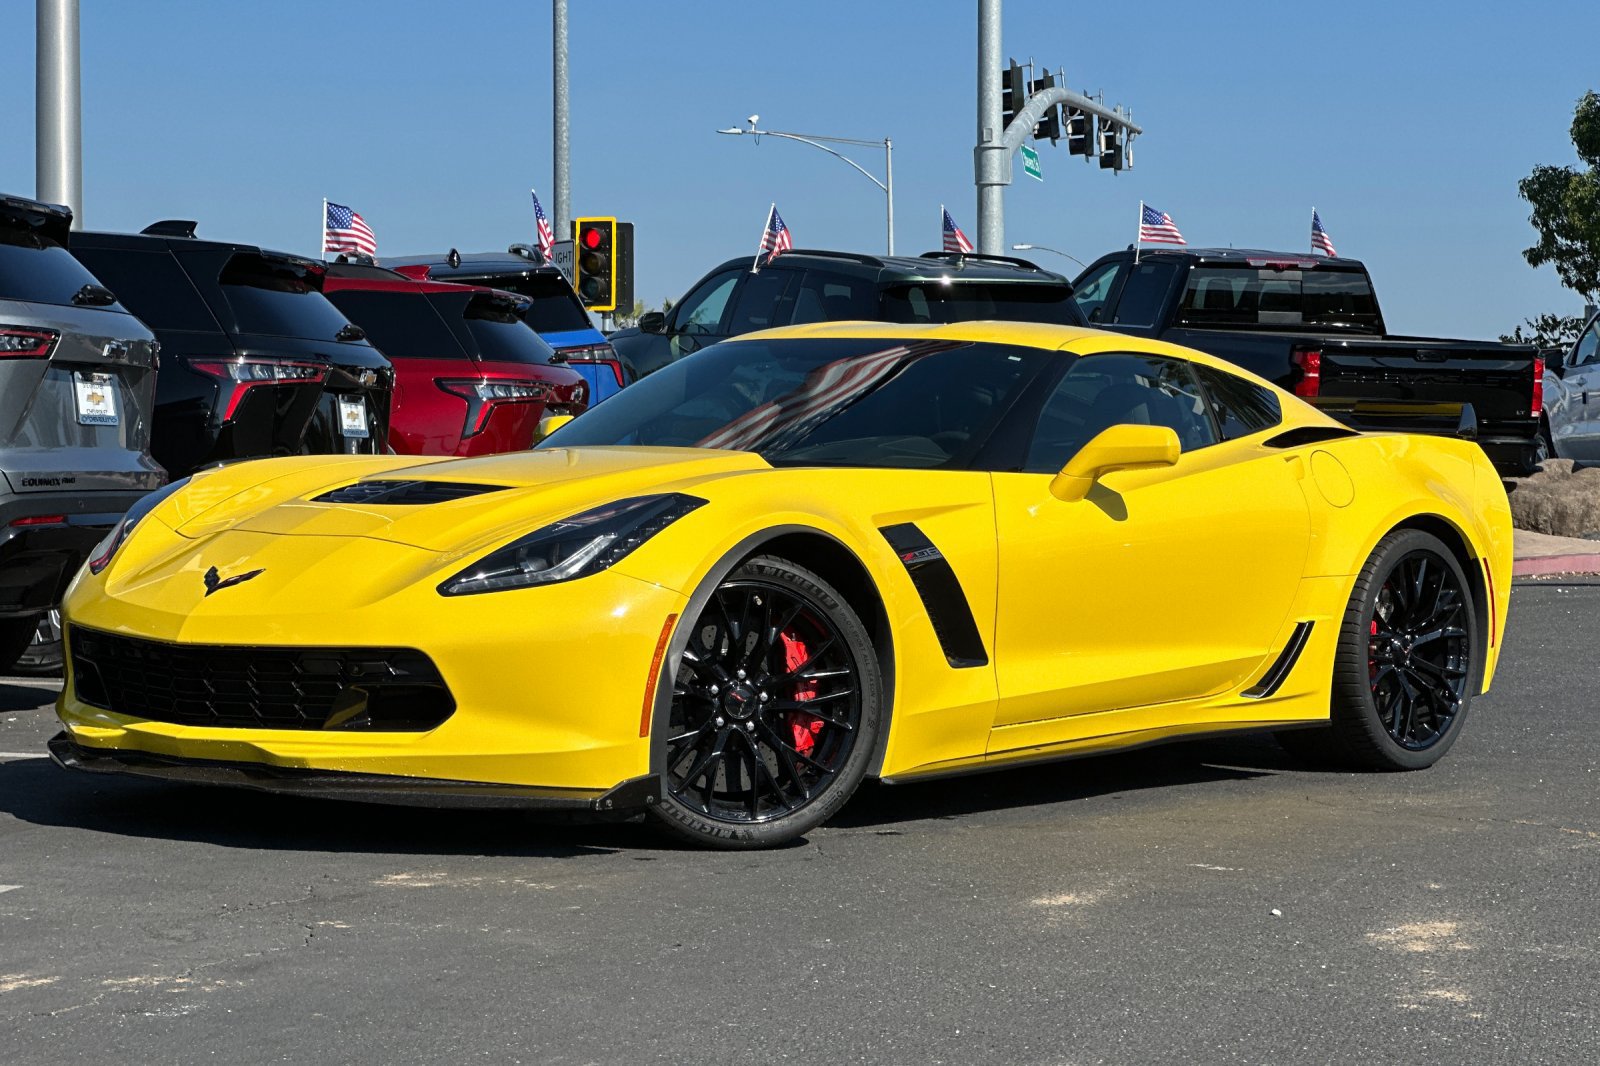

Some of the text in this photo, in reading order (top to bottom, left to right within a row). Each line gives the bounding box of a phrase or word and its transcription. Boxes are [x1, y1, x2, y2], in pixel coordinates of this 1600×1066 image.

[555, 251, 572, 263] IGHT
[21, 477, 61, 487] EQUINOX
[762, 565, 837, 608] MICHELIN
[659, 800, 733, 839] MICHELIN
